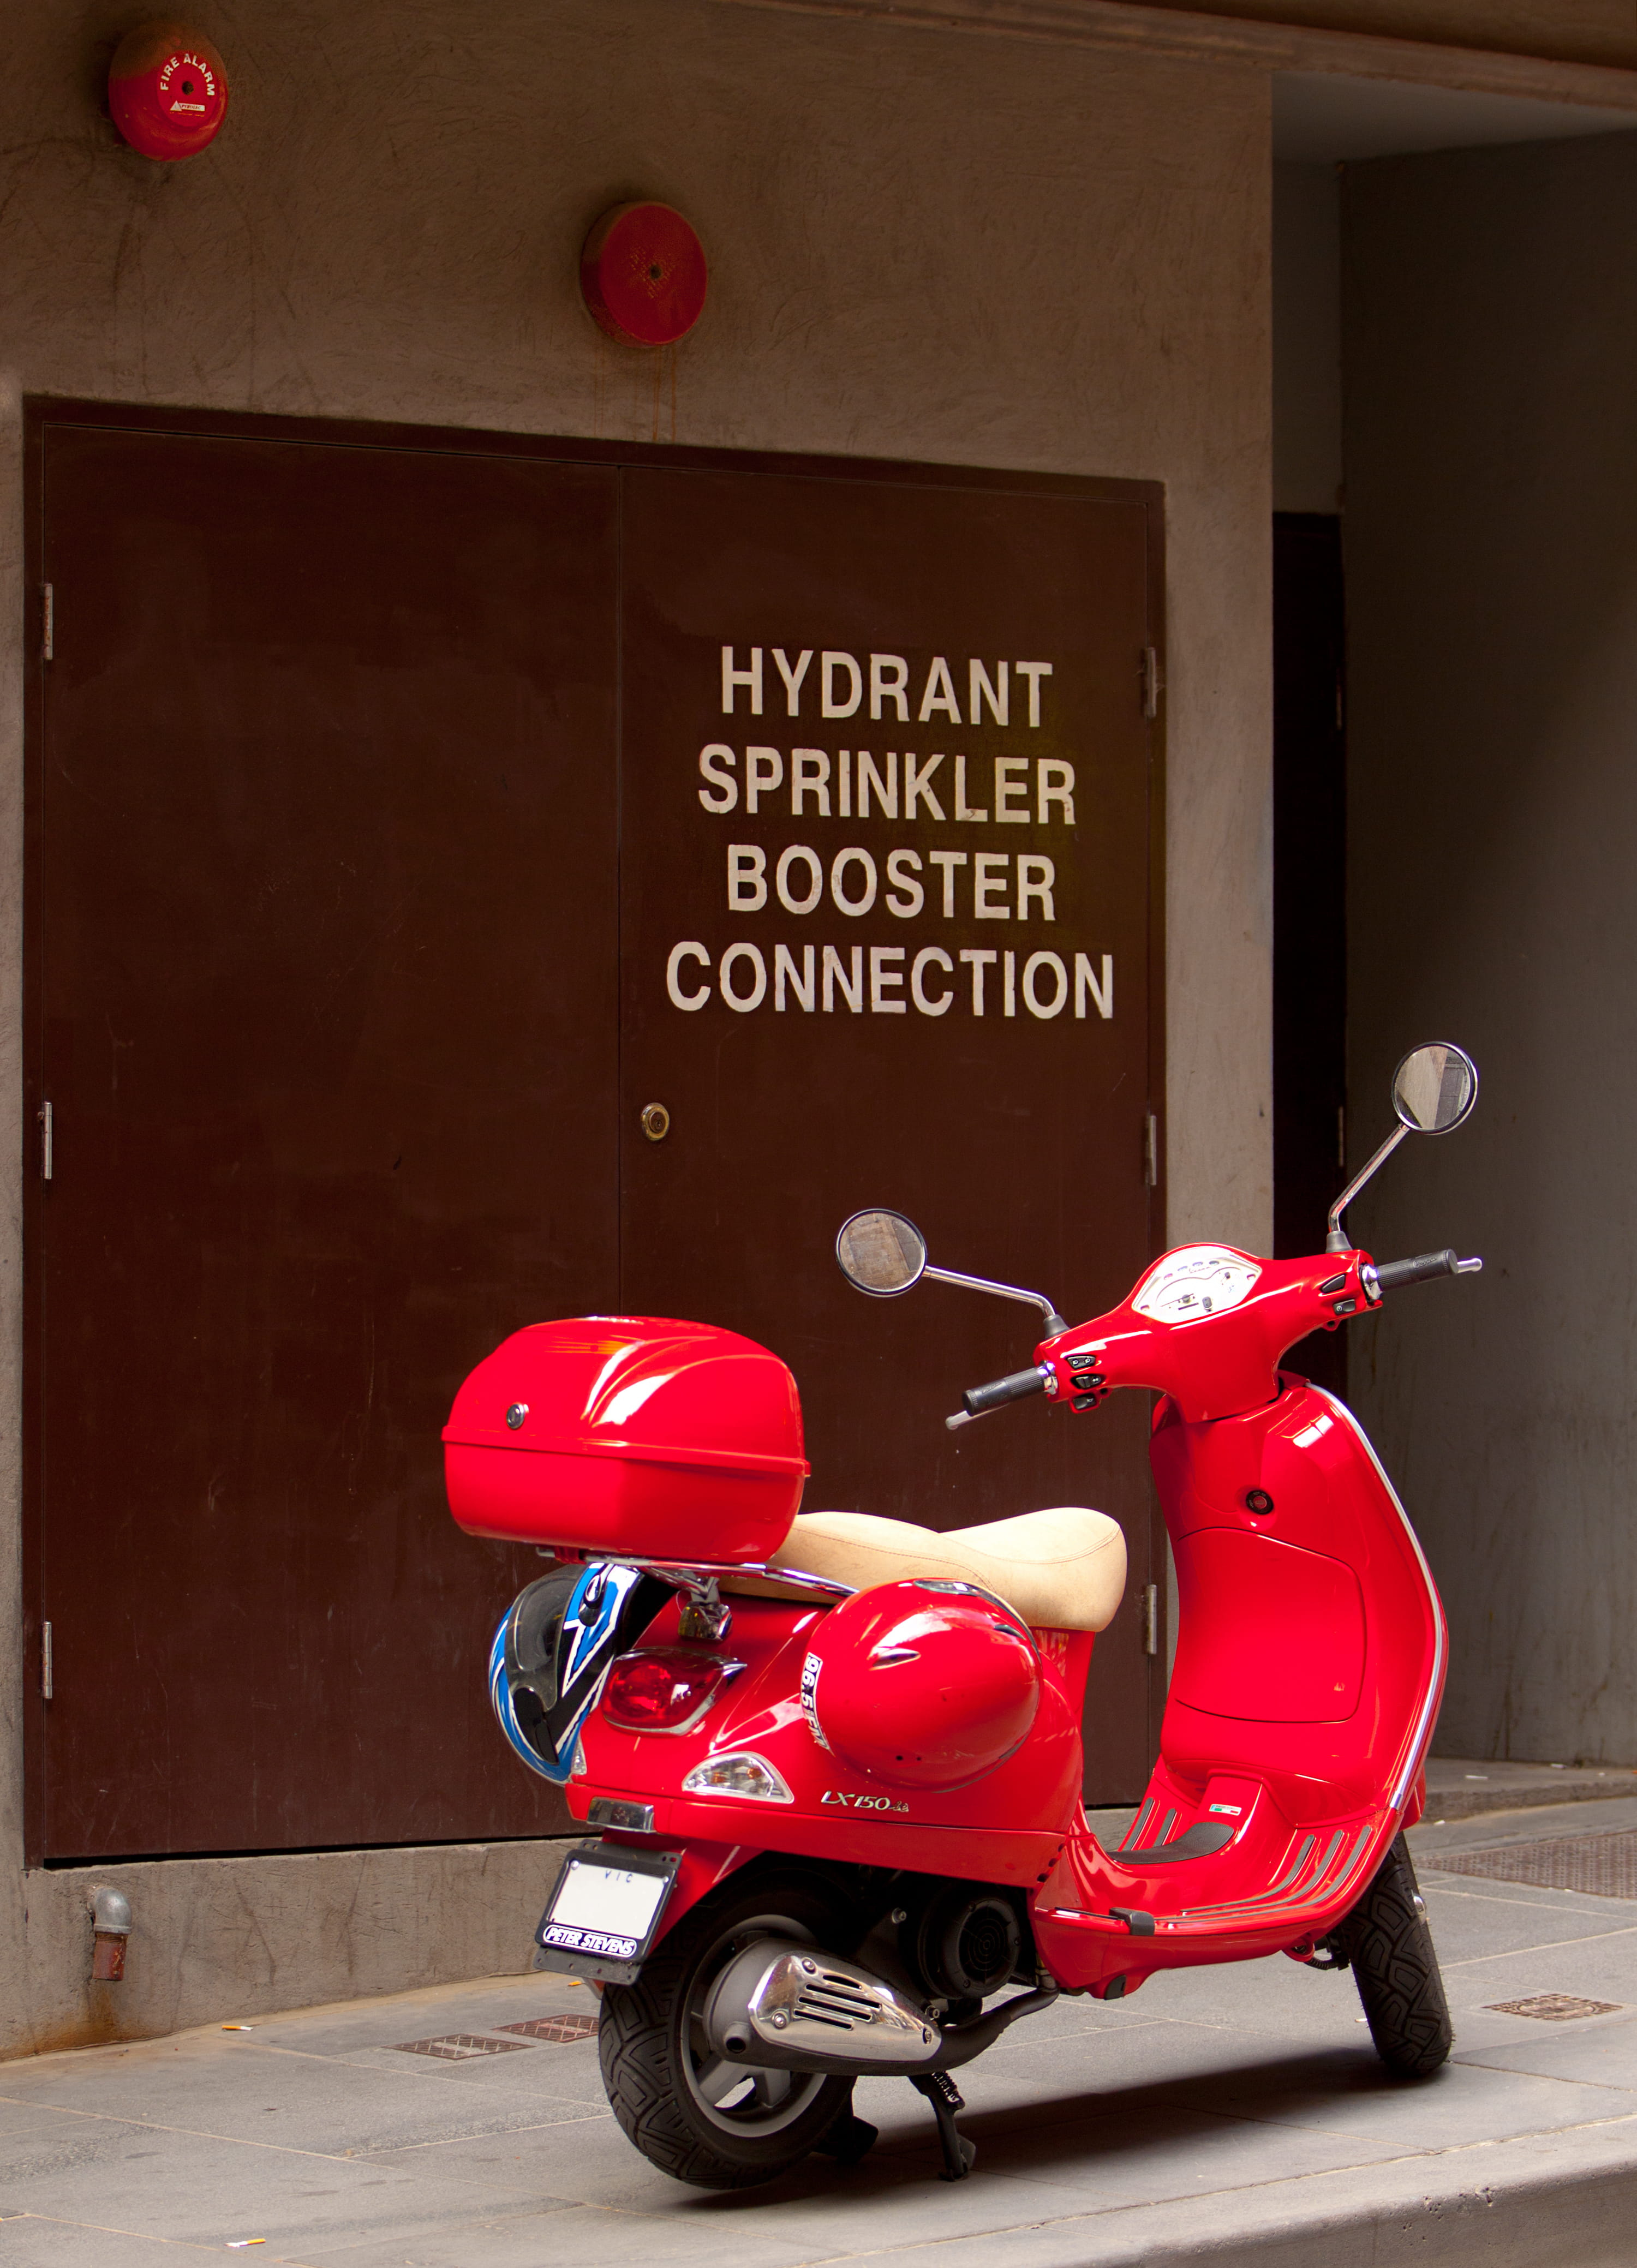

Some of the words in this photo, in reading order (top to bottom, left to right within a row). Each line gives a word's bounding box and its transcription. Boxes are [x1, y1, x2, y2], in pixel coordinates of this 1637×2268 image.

[160, 57, 180, 91] FIRE
[183, 53, 215, 96] ALARM
[722, 646, 1053, 727] HYDRANT
[698, 744, 1076, 825] SPRINKLER
[727, 844, 1055, 921] BOOSTER
[666, 941, 1113, 1019] CONNECTION
[605, 1870, 633, 1883] VIC
[546, 1927, 582, 1946] PETER
[581, 1934, 635, 1955] STEVENS
